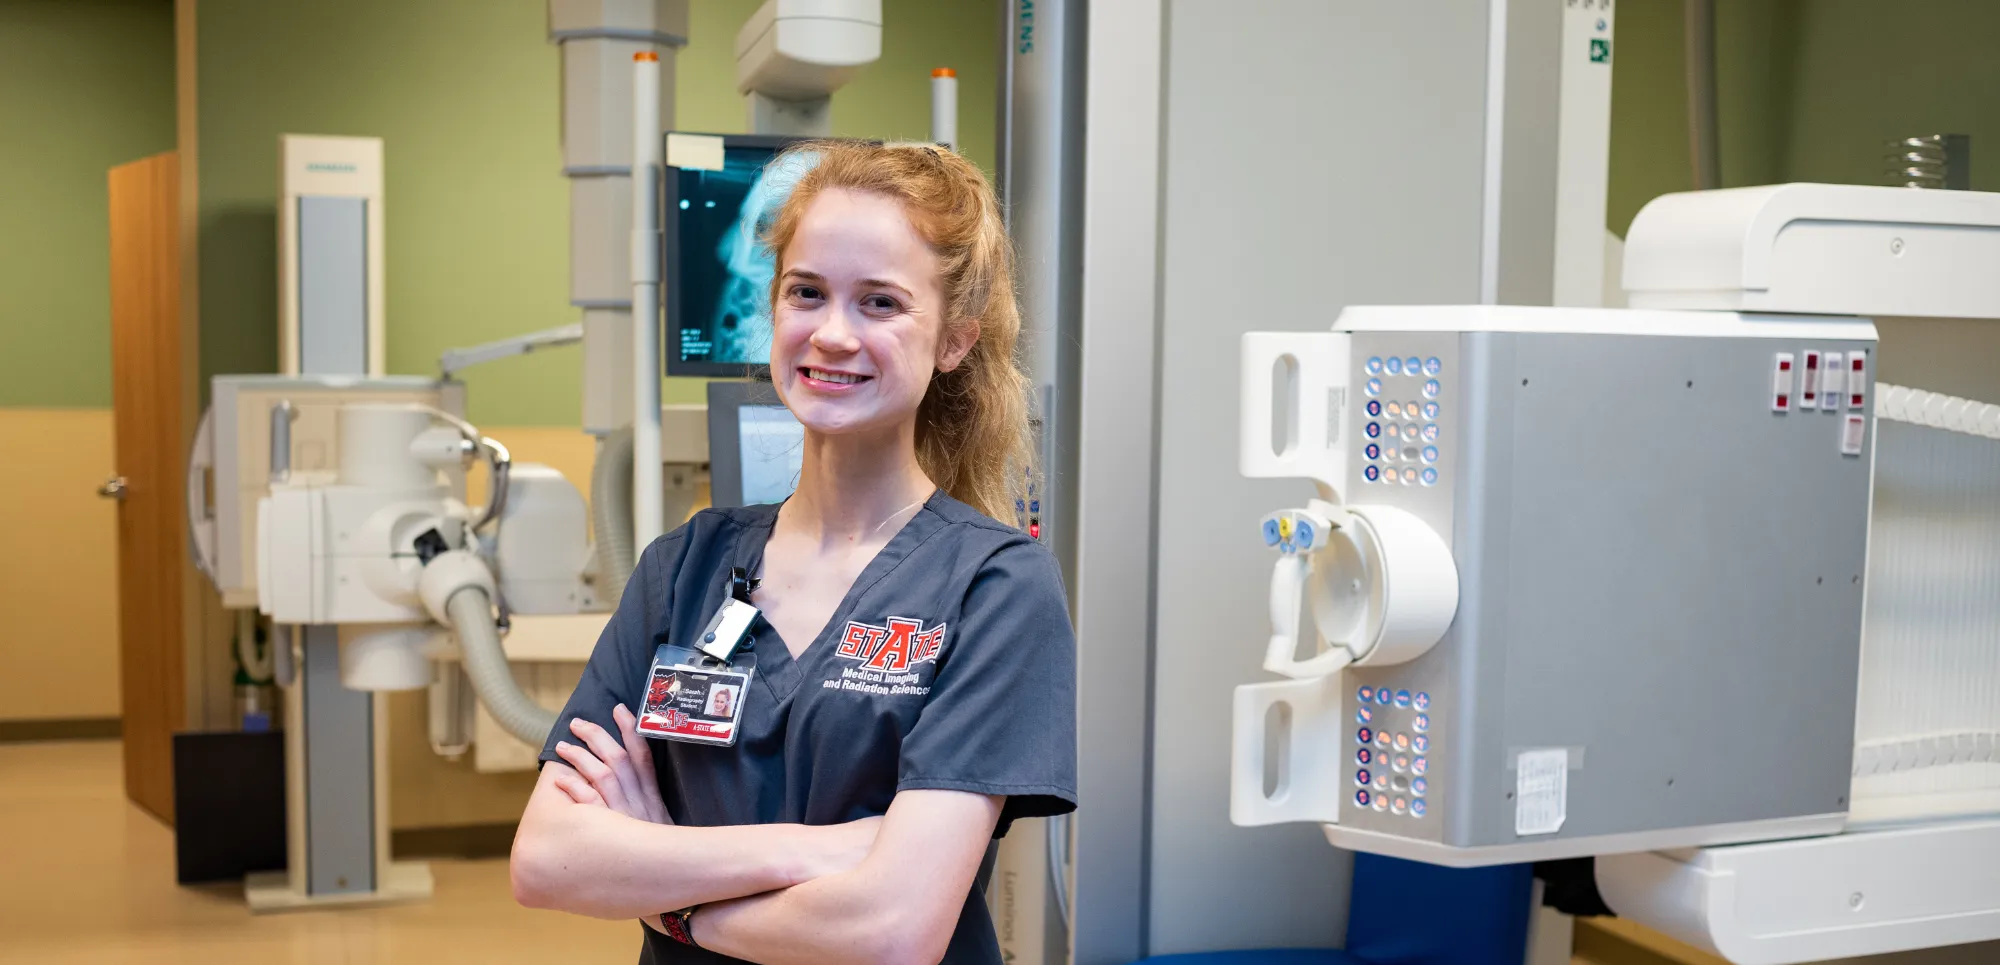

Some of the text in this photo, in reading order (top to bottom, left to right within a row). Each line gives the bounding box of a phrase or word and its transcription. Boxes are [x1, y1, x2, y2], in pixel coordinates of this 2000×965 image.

[835, 616, 946, 673] STATE
[842, 667, 919, 684] Medical Imaging
[823, 679, 841, 690] and
[842, 680, 889, 695] Radiation
